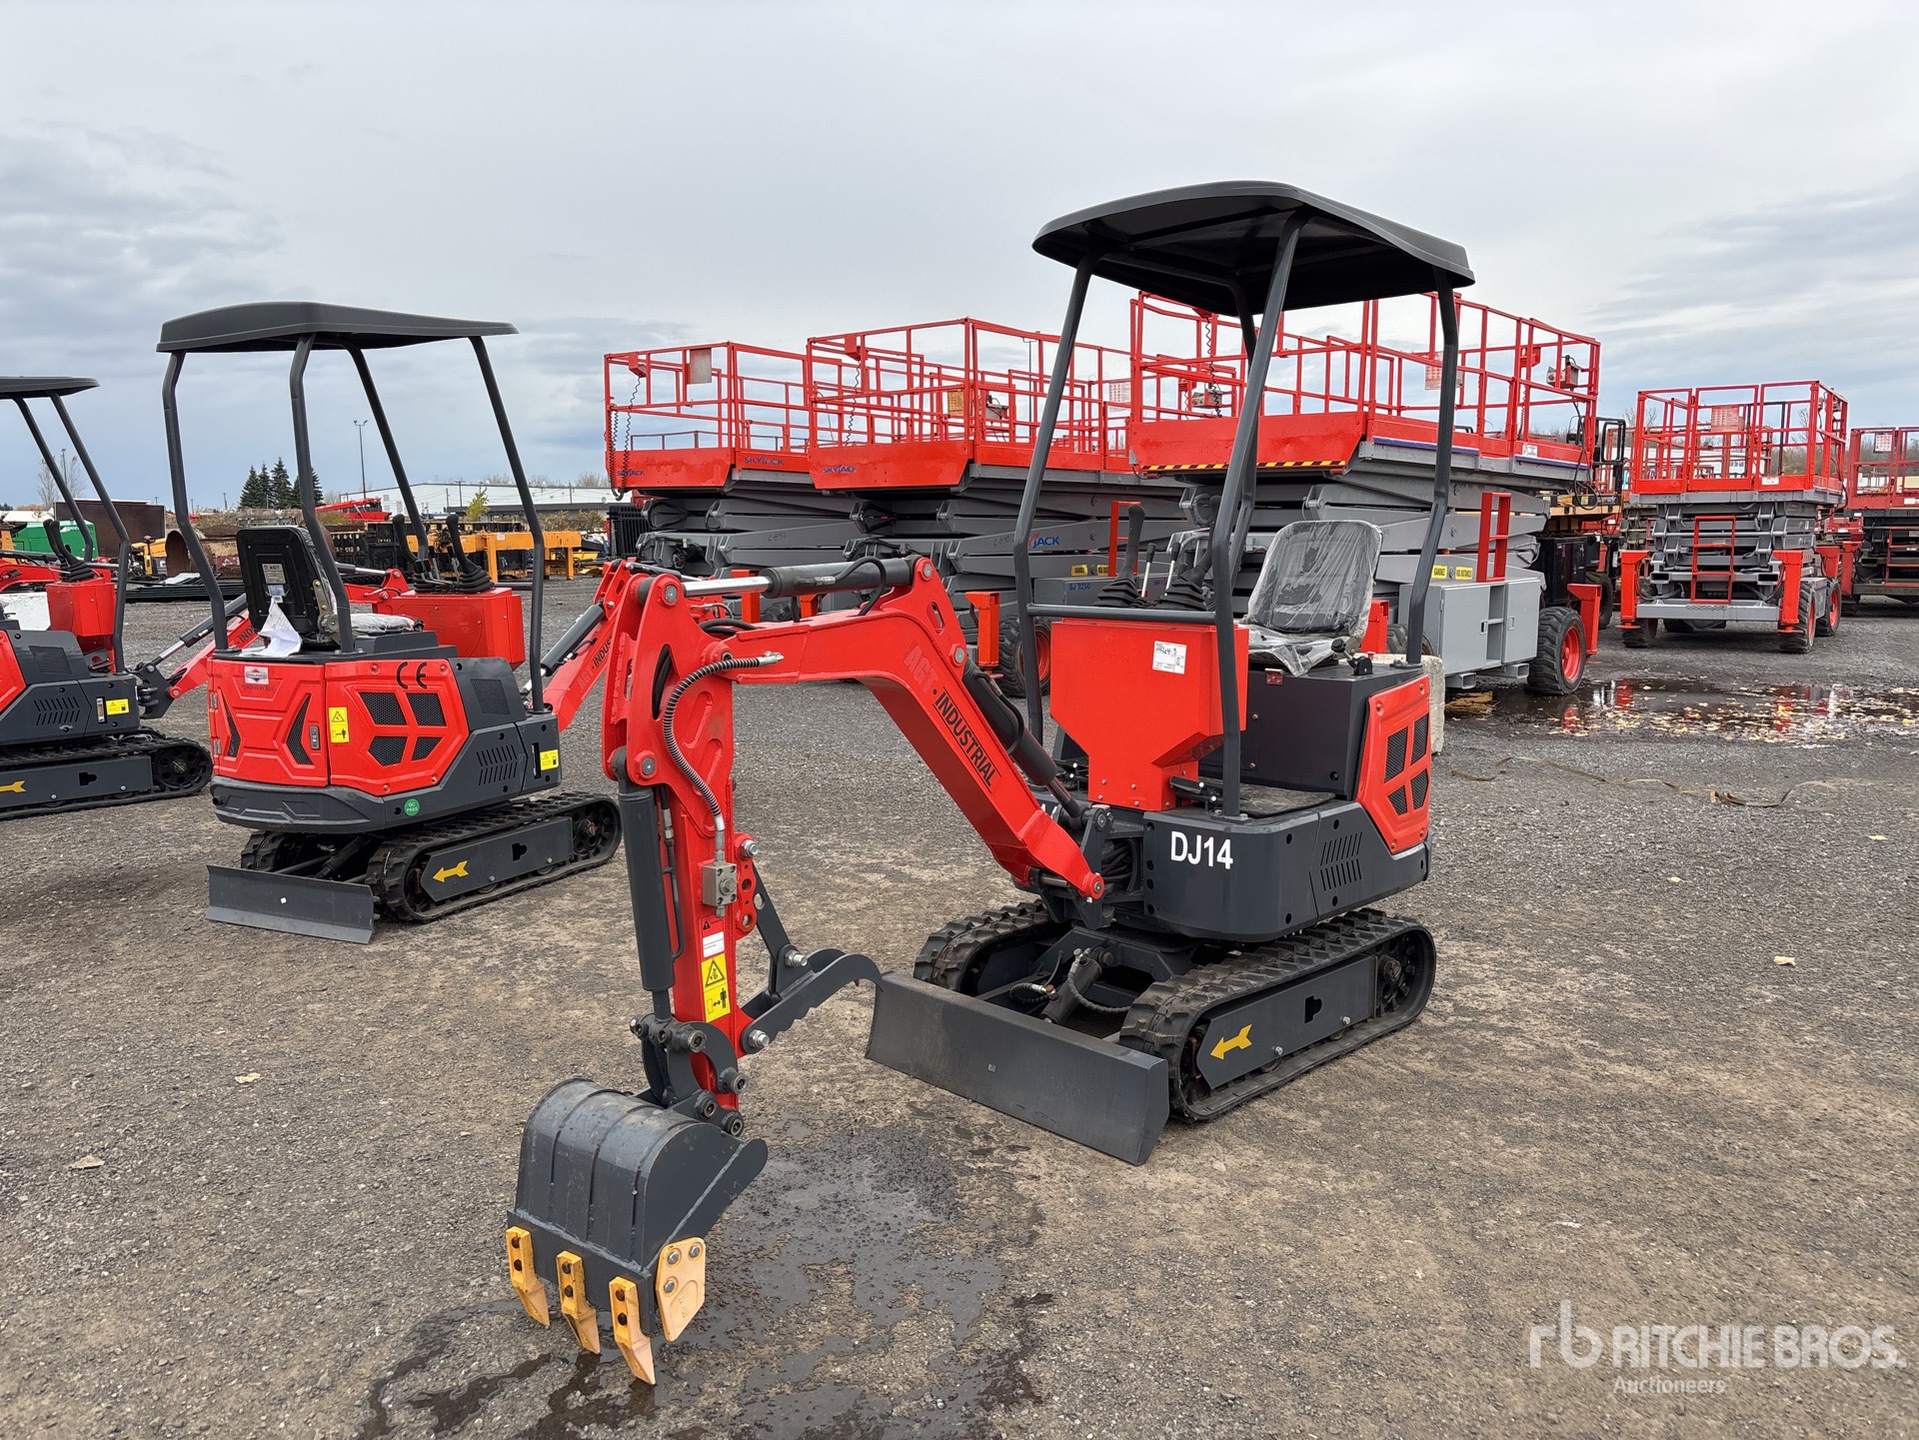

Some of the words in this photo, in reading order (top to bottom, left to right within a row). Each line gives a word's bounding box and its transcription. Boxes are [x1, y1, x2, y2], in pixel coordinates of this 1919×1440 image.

[744, 454, 784, 466] SKYJACK
[823, 464, 857, 474] SKYJACK
[396, 661, 428, 690] CE
[903, 645, 940, 694] AGT
[934, 691, 997, 788] INDUSTRIAL
[1170, 830, 1234, 870] DJ14
